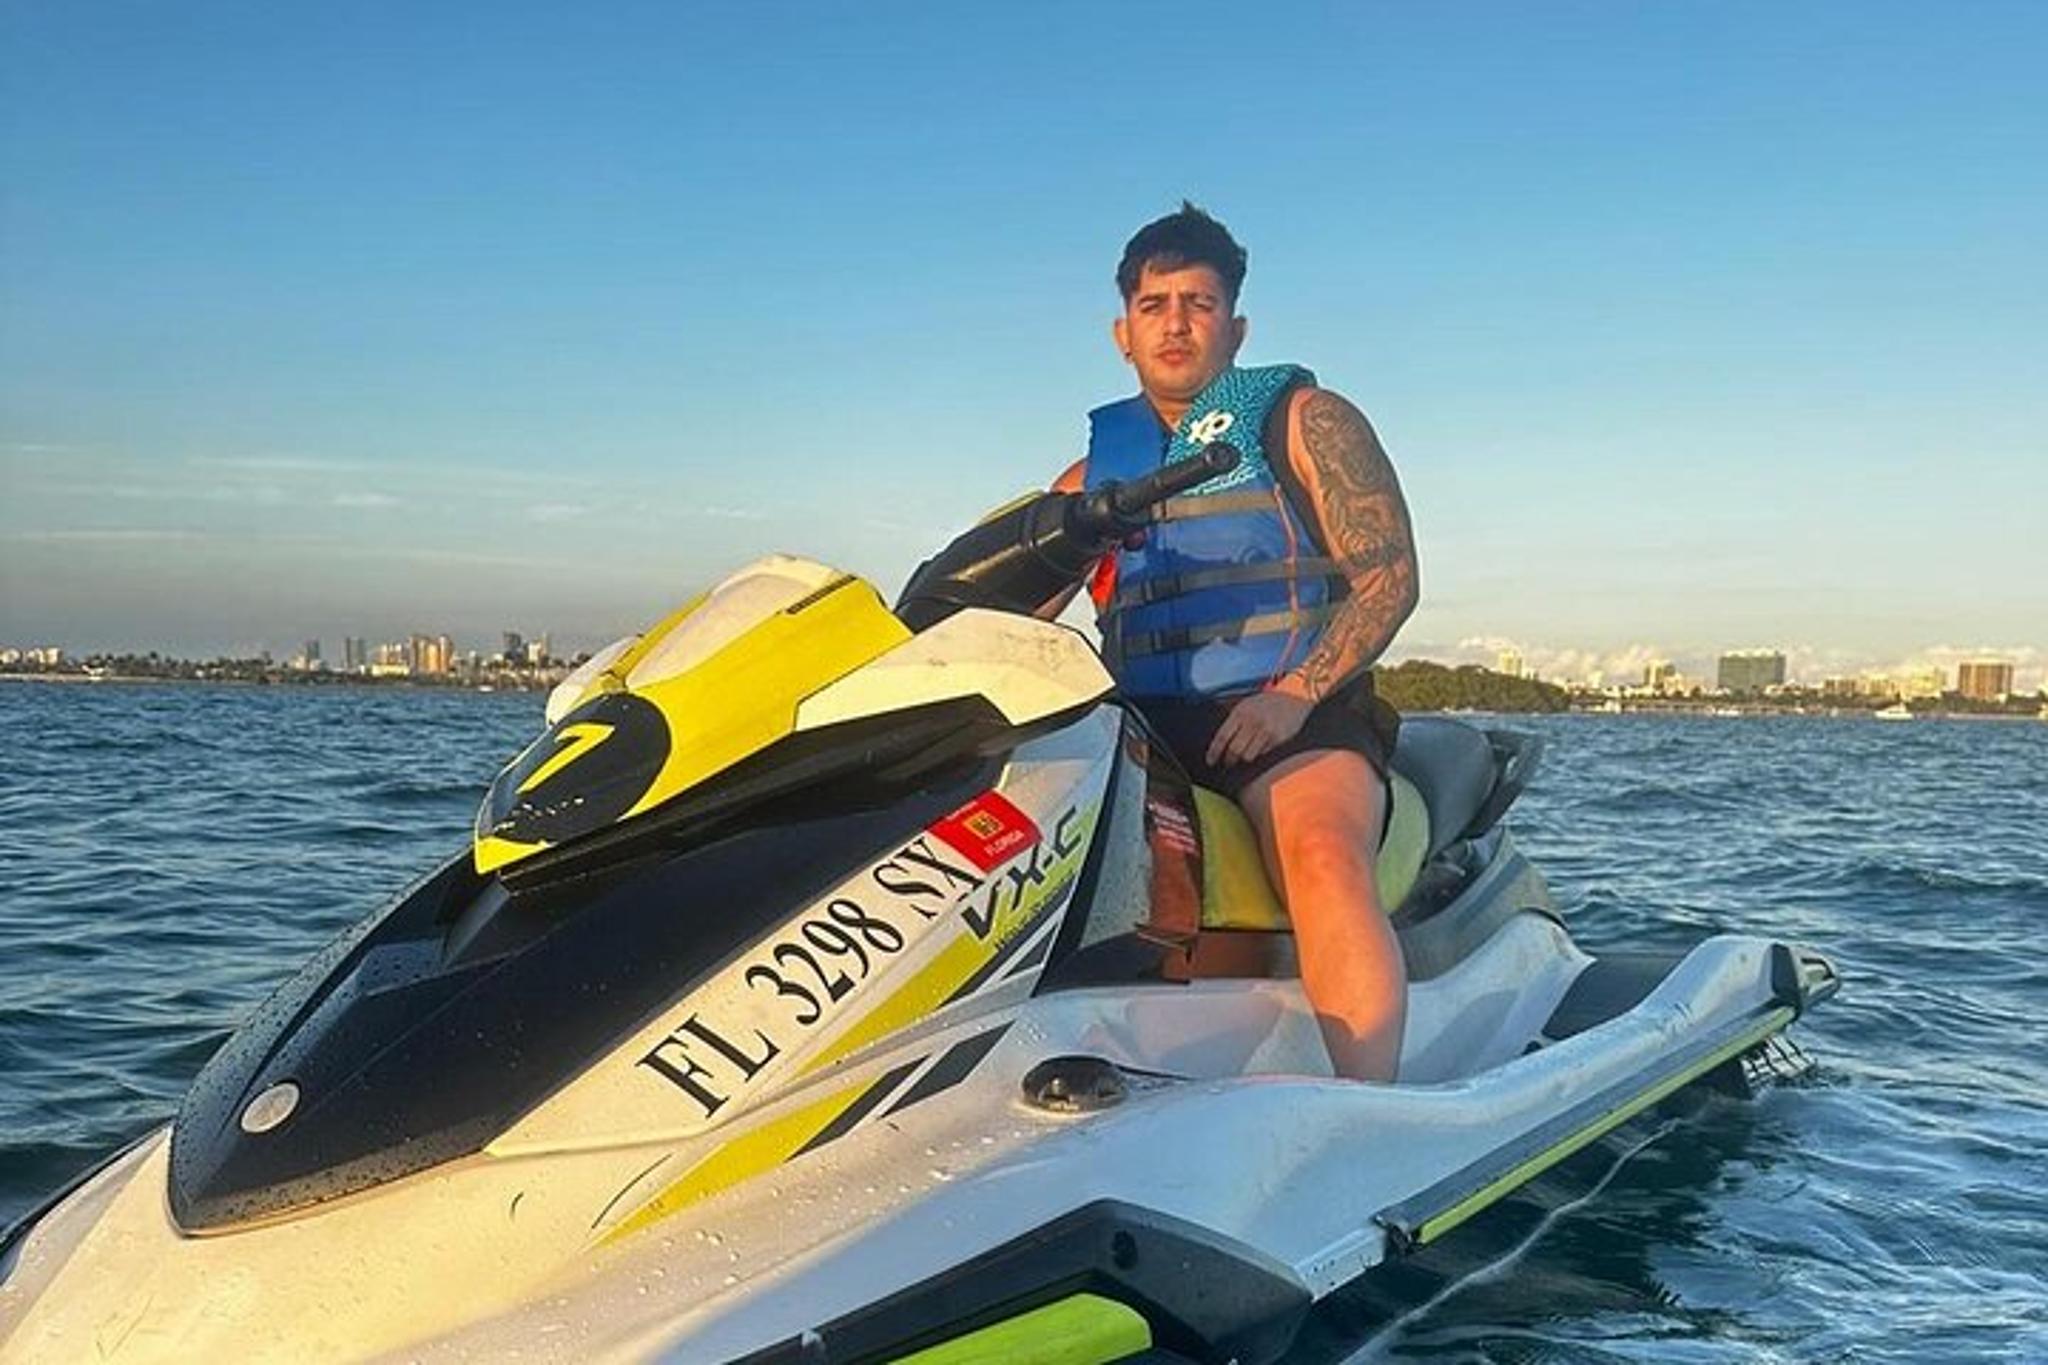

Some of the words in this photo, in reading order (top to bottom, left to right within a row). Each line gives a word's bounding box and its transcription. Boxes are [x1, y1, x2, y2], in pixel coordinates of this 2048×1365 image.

[515, 723, 616, 796] 7
[634, 1014, 781, 1119] FL
[745, 899, 905, 1025] 3298
[873, 837, 985, 920] SX
